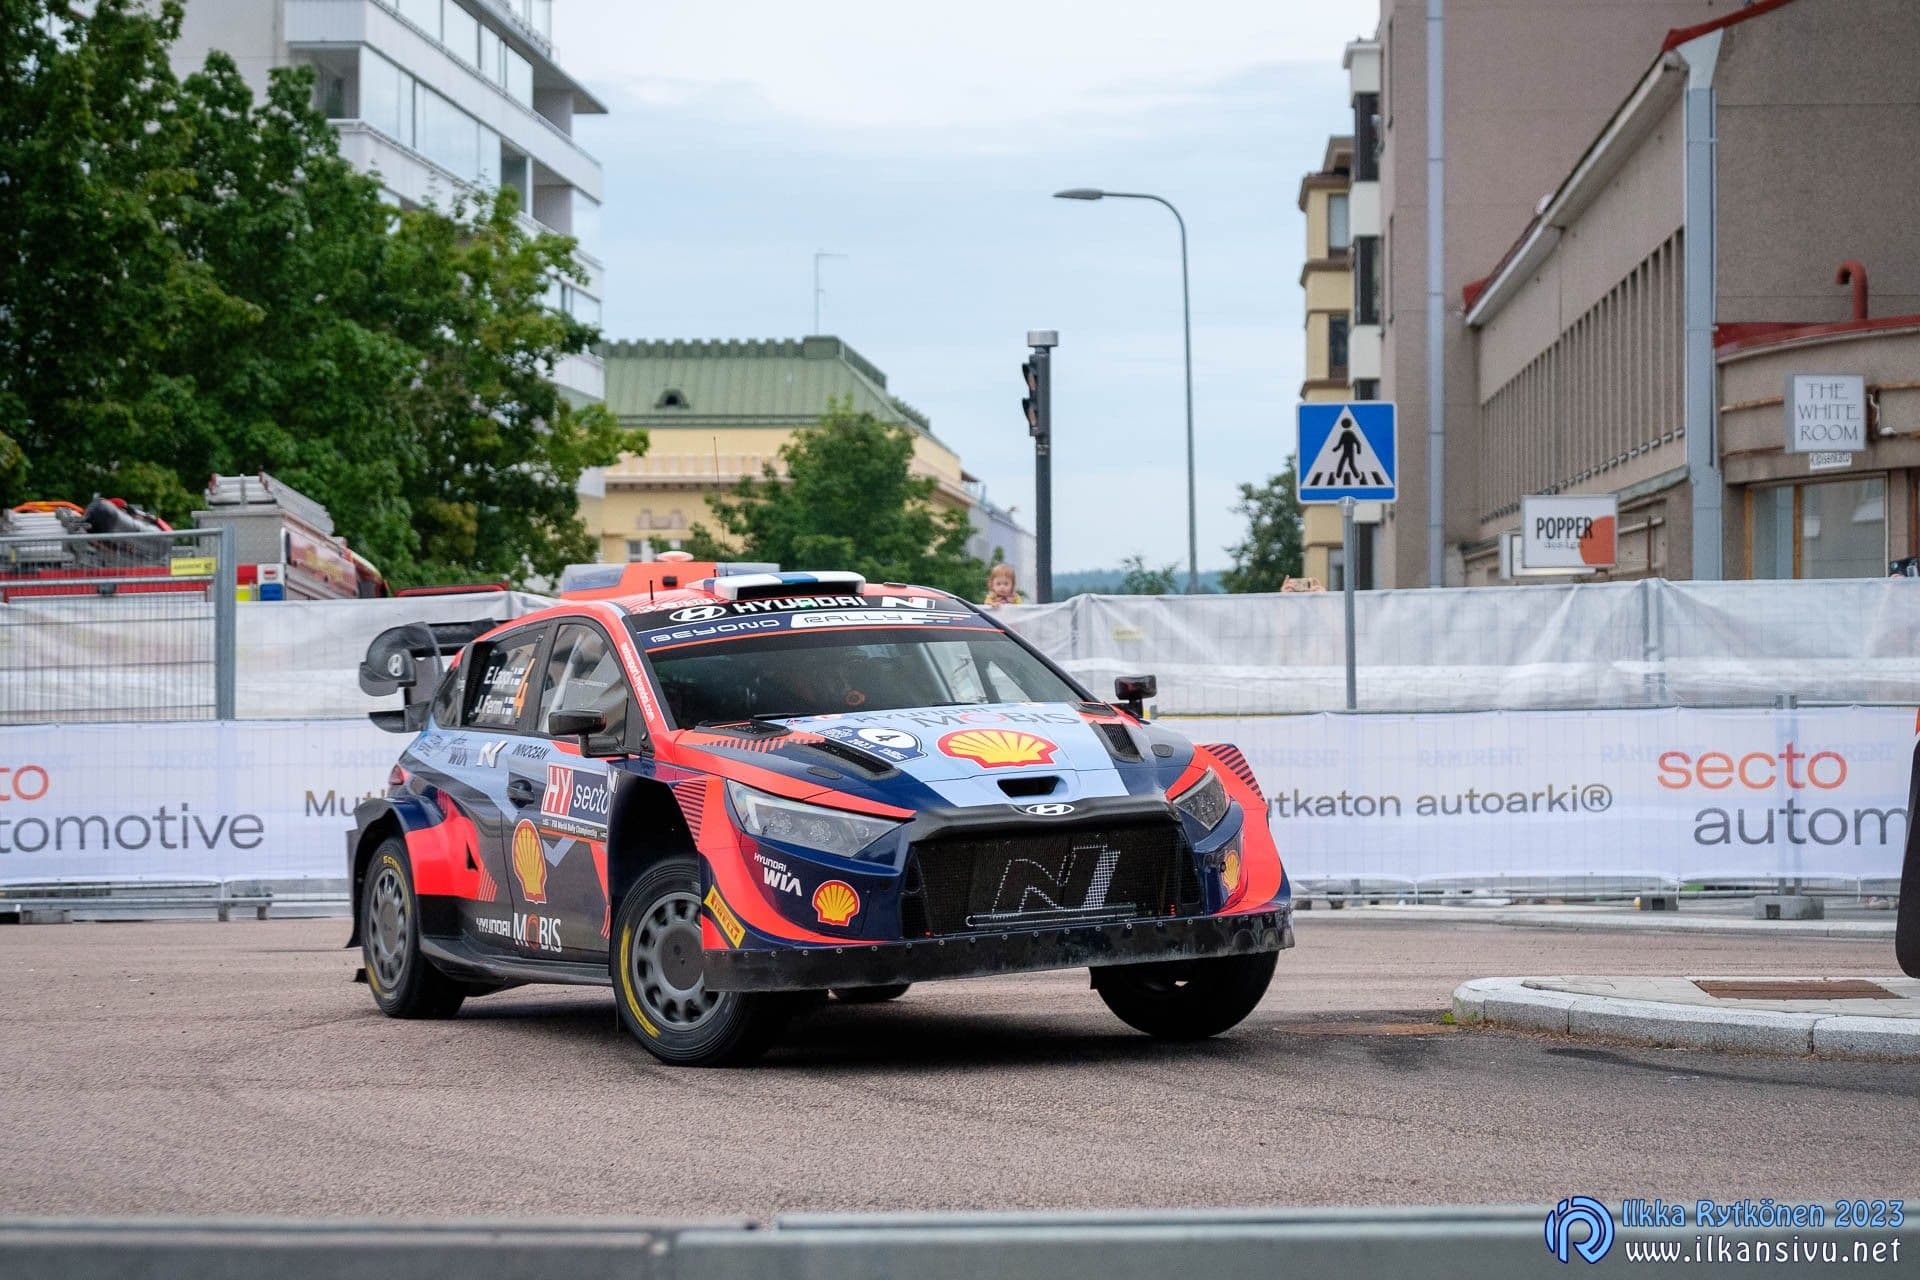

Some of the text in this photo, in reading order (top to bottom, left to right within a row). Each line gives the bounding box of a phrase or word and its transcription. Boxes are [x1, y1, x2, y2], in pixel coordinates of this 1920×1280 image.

[1807, 383, 1848, 399] THE
[1798, 403, 1861, 419] WHITE
[1800, 424, 1858, 441] ROOM
[1536, 517, 1593, 539] POPPER
[732, 596, 868, 614] HYUNDAI
[881, 596, 935, 609] N
[650, 613, 903, 644] BEYOND RALLY
[855, 705, 992, 724] HYUNDAI
[911, 709, 1081, 729] MOBIS
[875, 734, 900, 742] 4
[476, 740, 508, 768] N
[1657, 742, 1848, 790] secto
[543, 766, 573, 815] HY
[754, 852, 787, 872] HYUNDAI
[763, 866, 802, 897] WIA
[710, 891, 741, 940] PIRELLI
[476, 912, 562, 953] HYUNDAI MOBIS
